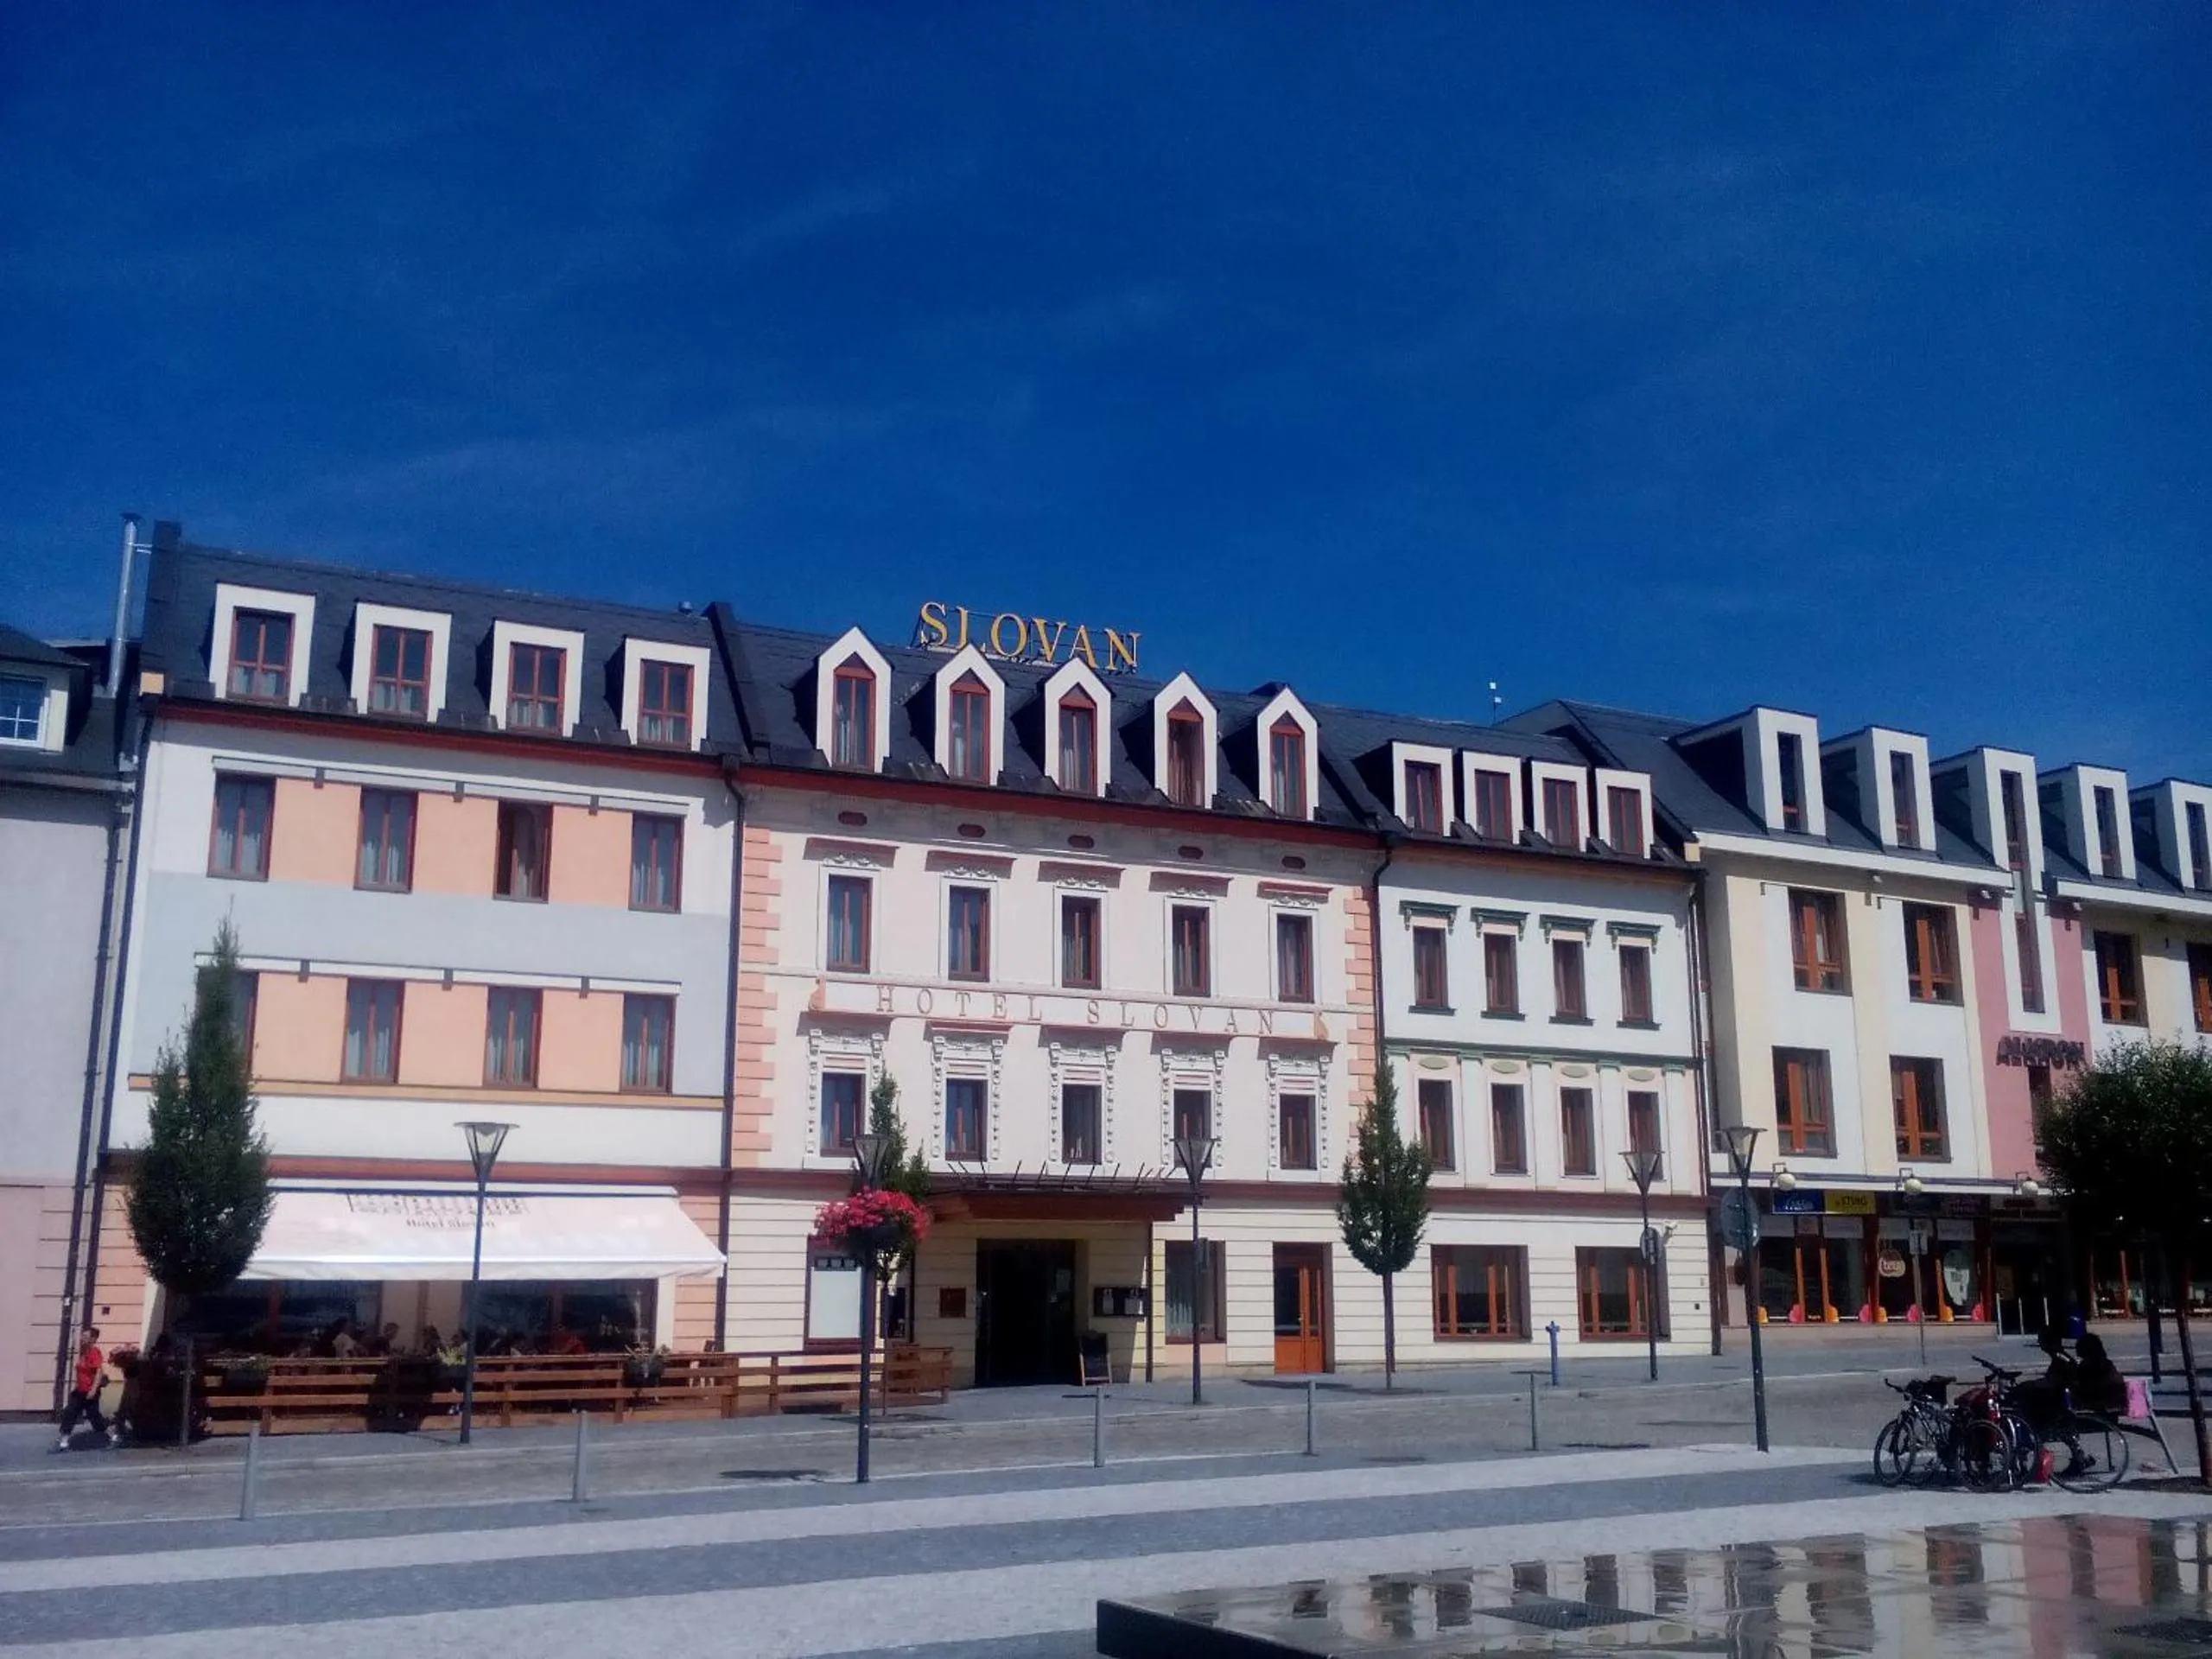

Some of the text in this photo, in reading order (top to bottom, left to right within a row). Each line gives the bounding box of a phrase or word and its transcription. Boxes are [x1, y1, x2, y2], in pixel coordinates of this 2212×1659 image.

[919, 601, 1141, 671] SLOVAN
[876, 984, 1274, 1034] HOTEL SLOVAN
